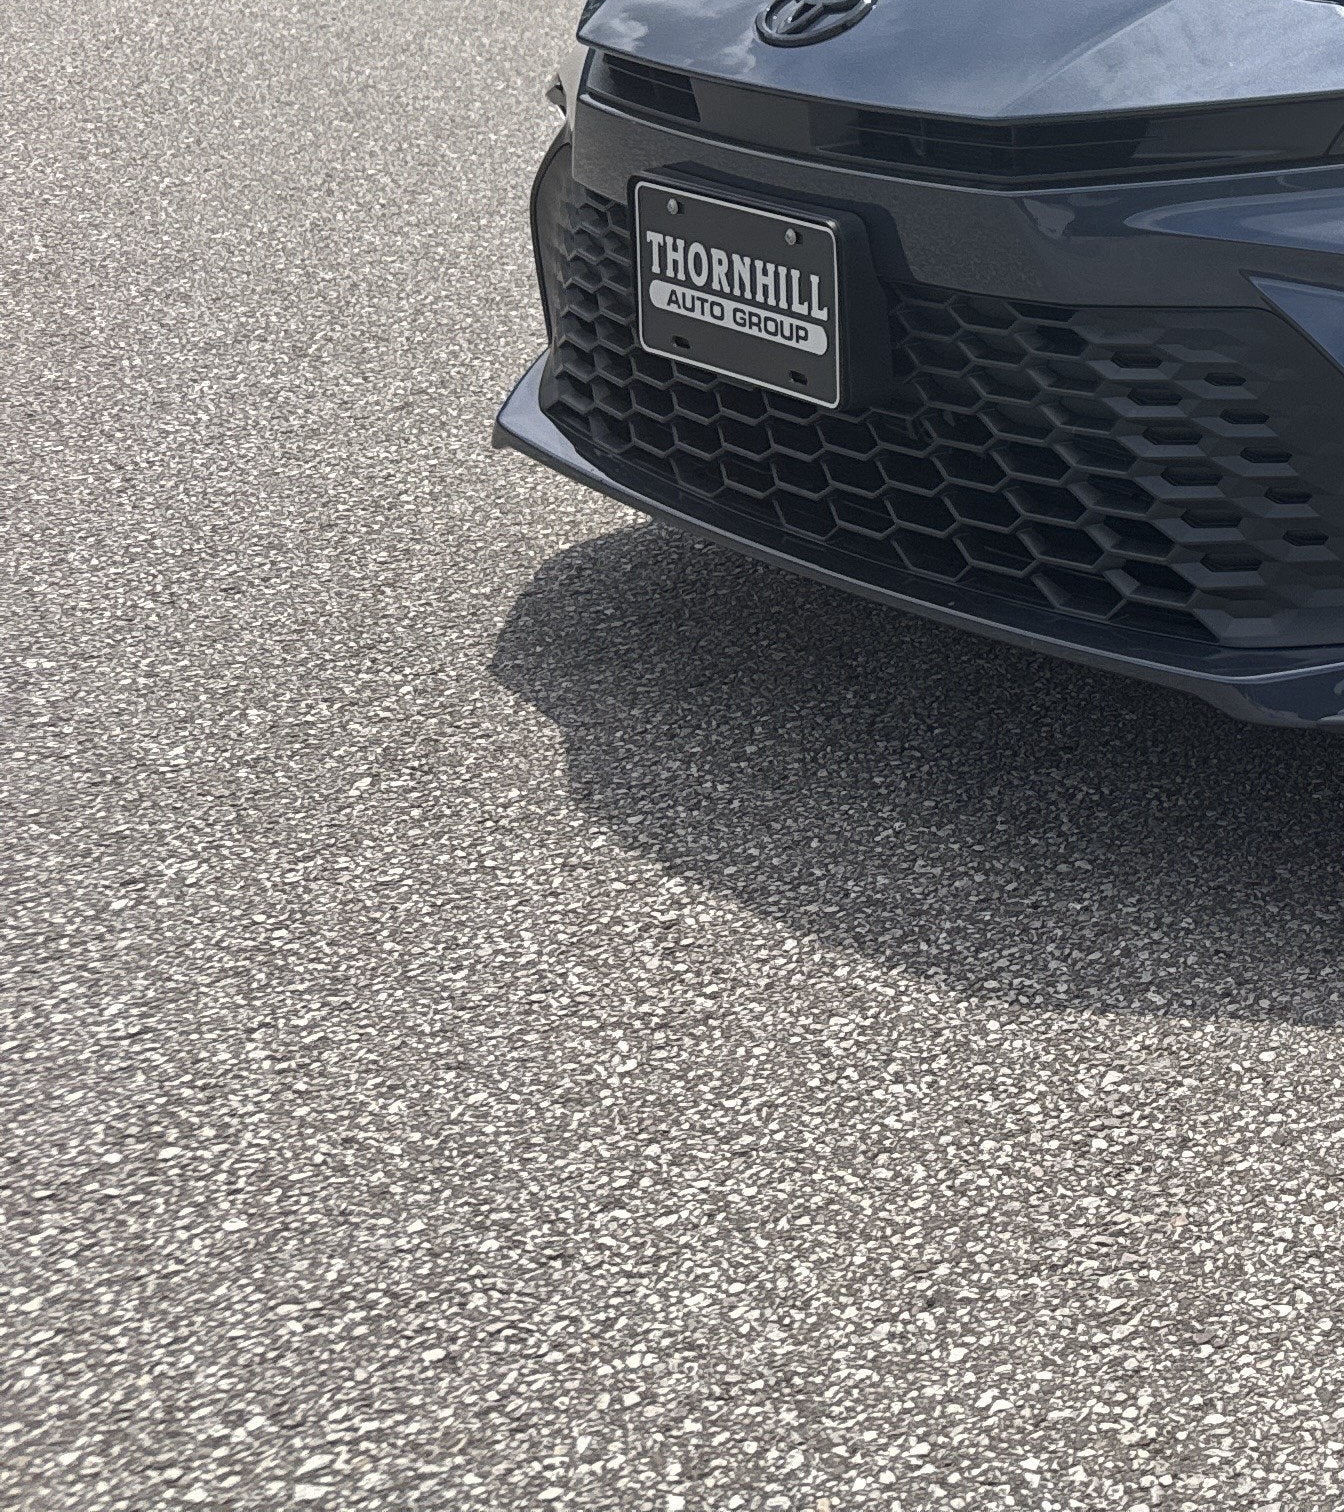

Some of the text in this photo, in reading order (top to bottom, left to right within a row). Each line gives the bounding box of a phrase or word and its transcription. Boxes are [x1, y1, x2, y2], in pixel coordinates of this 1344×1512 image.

[646, 230, 829, 322] THORNHILL
[666, 288, 809, 344] AUTO GROUP
